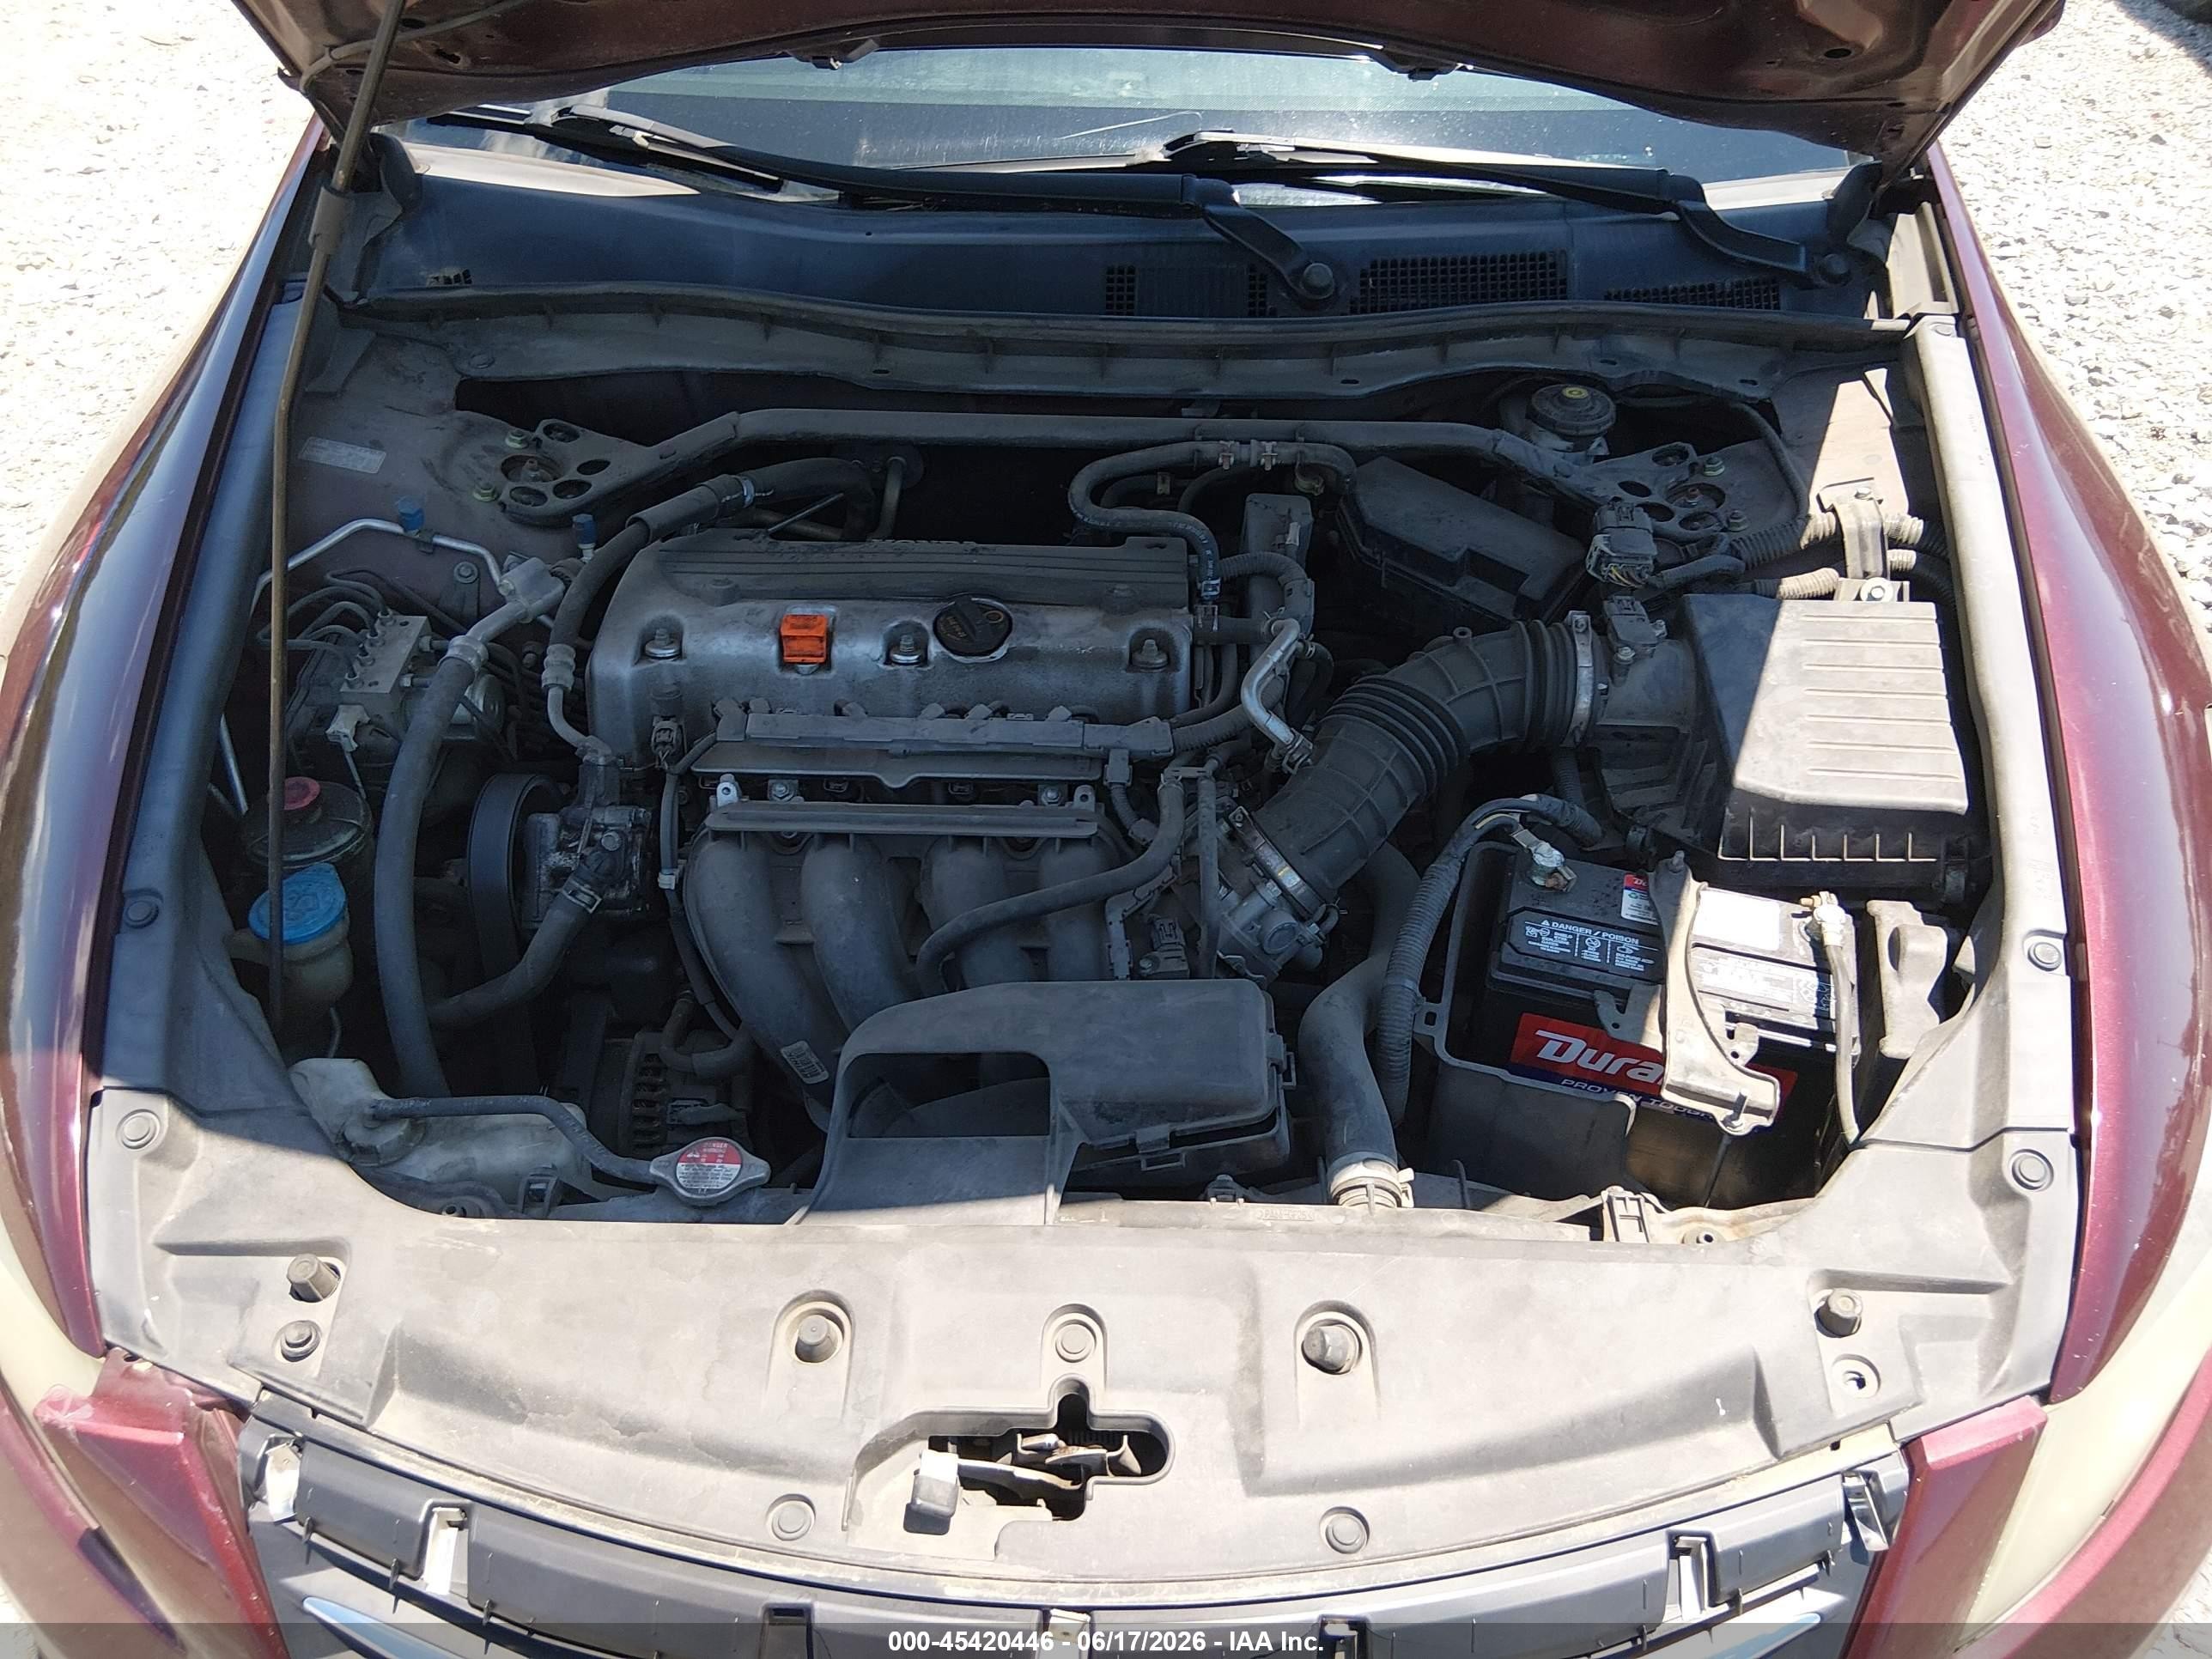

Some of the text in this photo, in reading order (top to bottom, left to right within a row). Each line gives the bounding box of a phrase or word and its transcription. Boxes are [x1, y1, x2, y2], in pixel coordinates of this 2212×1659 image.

[1552, 921, 1592, 935] DANGER
[1601, 933, 1639, 945] POISON
[1534, 1030, 1663, 1086] Dura
